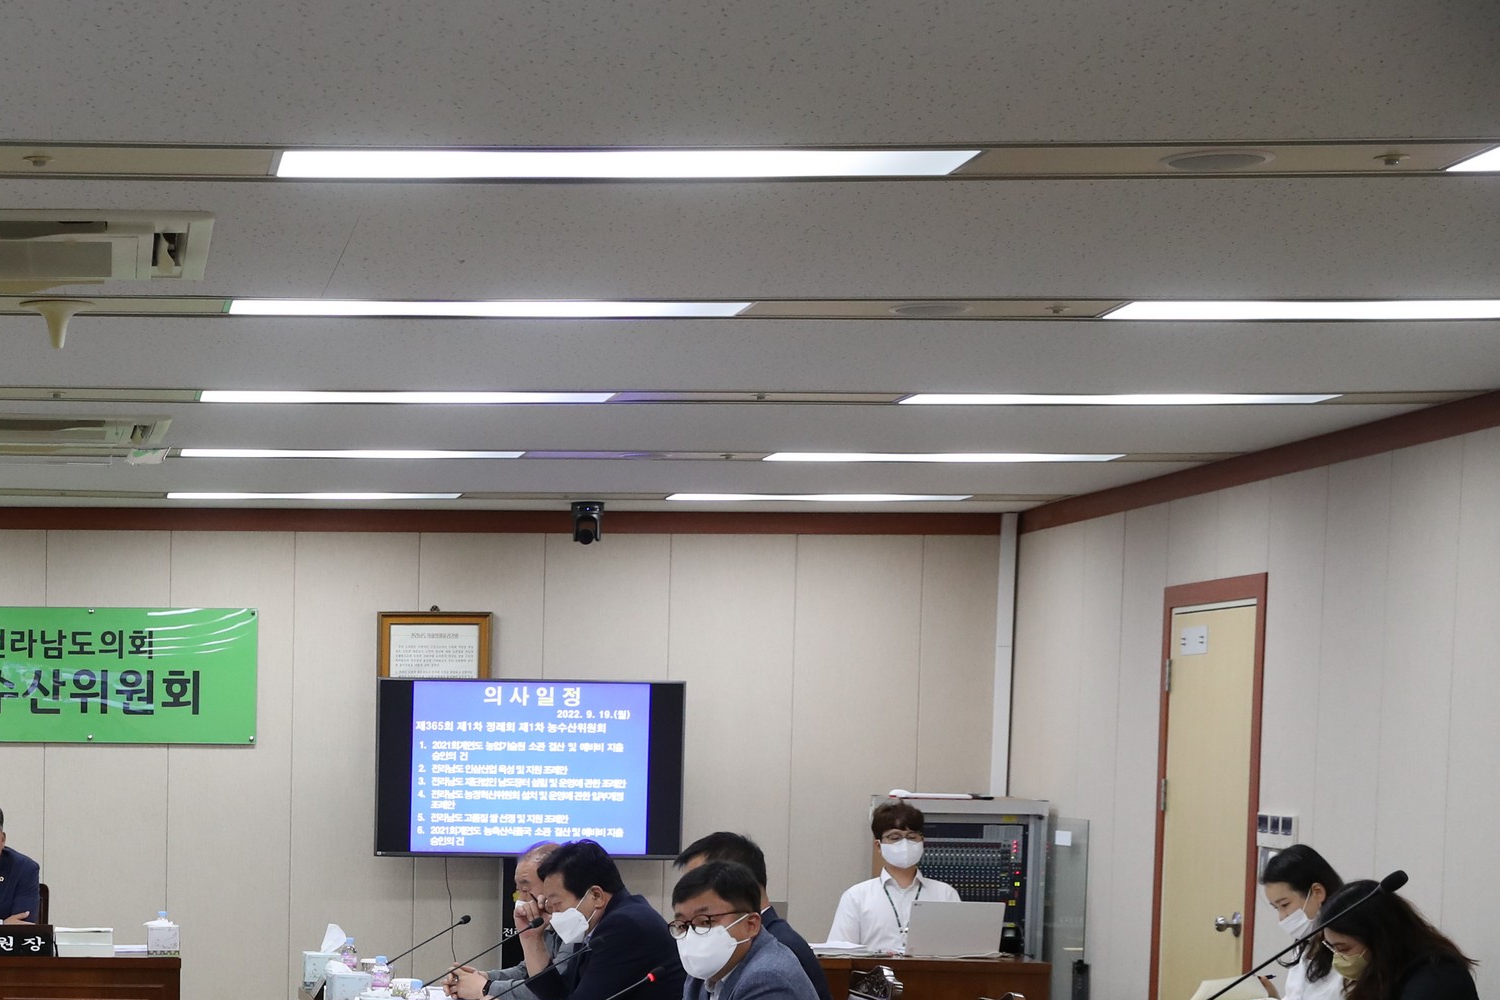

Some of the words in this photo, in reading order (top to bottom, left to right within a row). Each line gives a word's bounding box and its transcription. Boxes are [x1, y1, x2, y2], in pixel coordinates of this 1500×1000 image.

[556, 709, 583, 719] 2022.
[586, 710, 595, 719] 9.
[599, 709, 631, 720] 19.(월)
[415, 720, 454, 732] 제365회
[456, 720, 483, 732] 제1차
[486, 721, 516, 733] 정례회
[518, 721, 545, 733] 제1차
[547, 722, 607, 733] 농수산위원회
[420, 741, 426, 749] 1.
[460, 752, 468, 760] 건
[418, 764, 426, 772] 2.
[418, 777, 425, 785] 3.
[418, 790, 425, 798] 4.
[417, 813, 425, 821] 5.
[417, 826, 425, 834] 6.
[456, 837, 464, 846] 건
